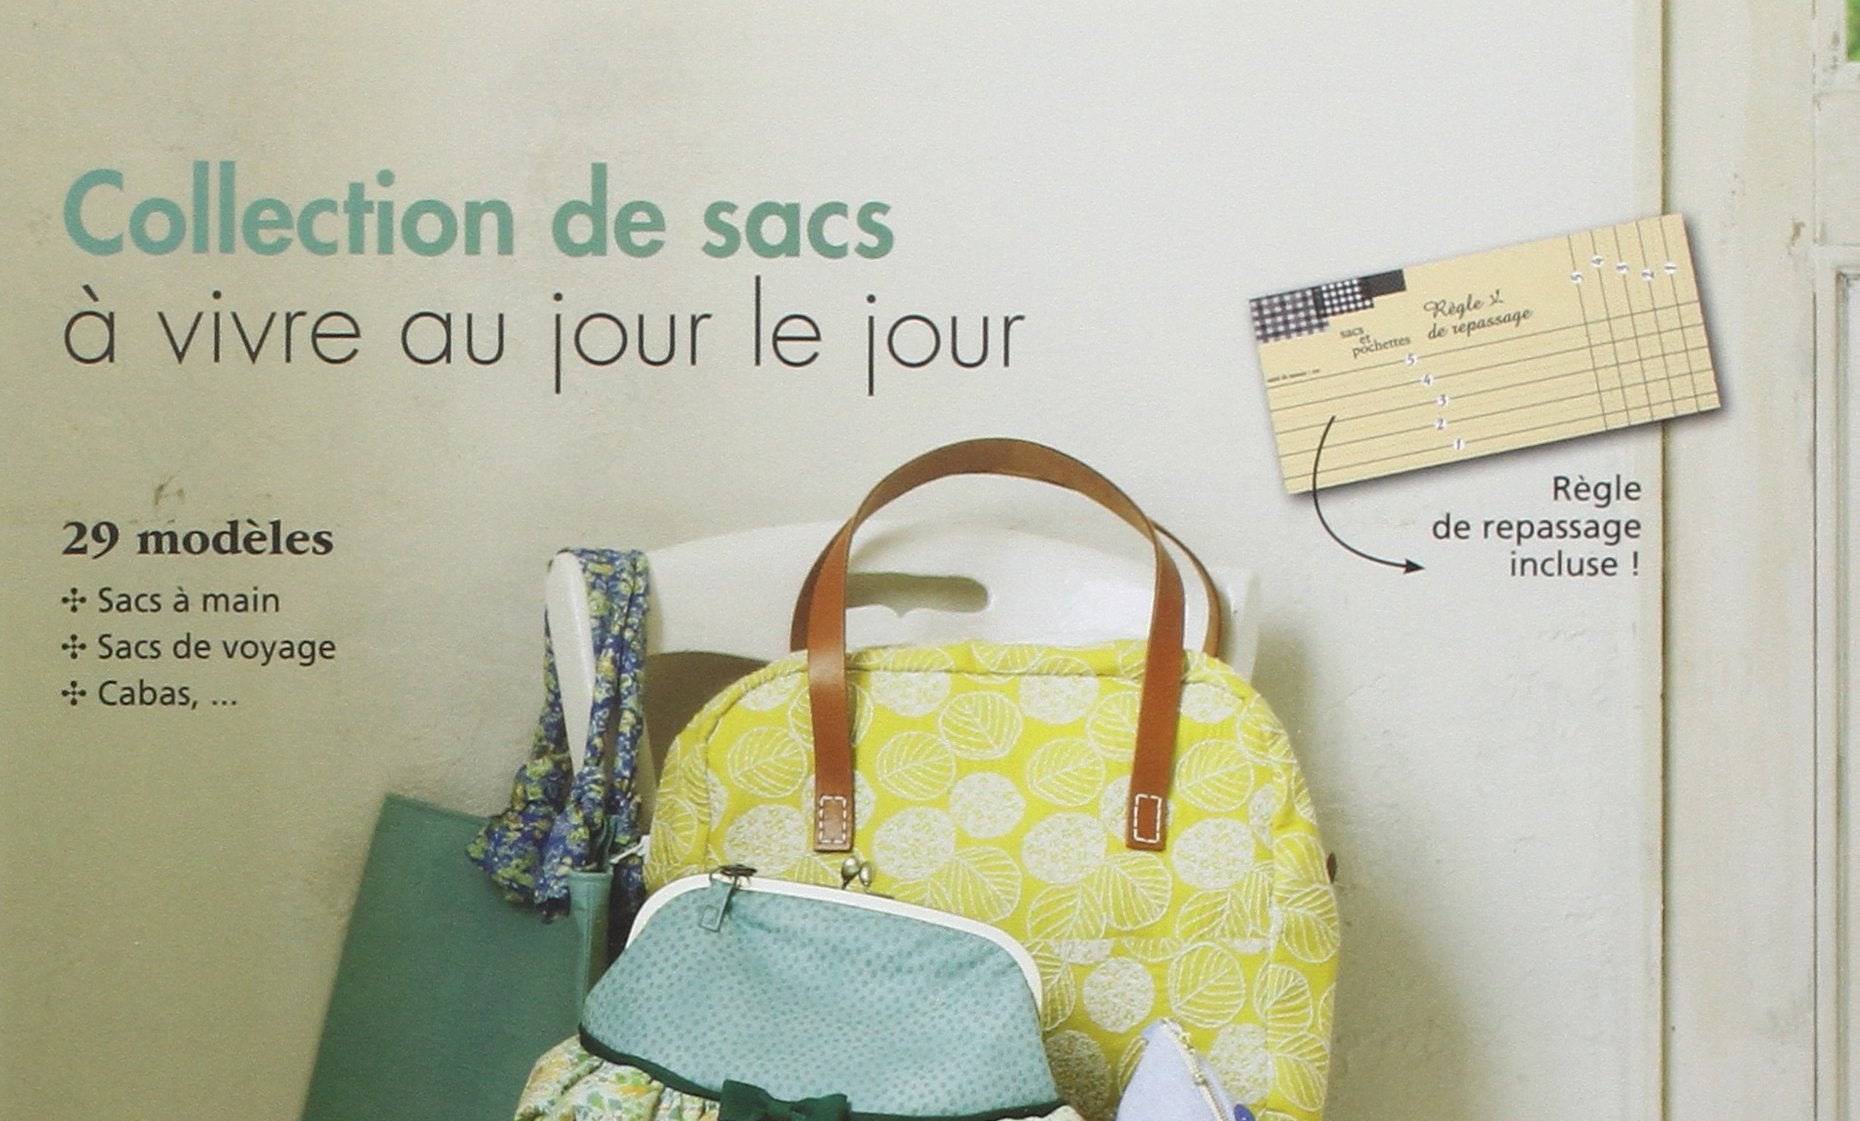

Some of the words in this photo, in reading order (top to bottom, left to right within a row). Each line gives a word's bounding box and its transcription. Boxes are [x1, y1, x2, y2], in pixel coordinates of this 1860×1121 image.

[63, 159, 513, 258] Collection
[552, 162, 665, 258] de
[703, 200, 894, 259] sacs
[1423, 293, 1485, 320] Règle
[64, 284, 115, 365] à
[157, 290, 361, 365] vivre
[400, 311, 504, 366] au
[552, 292, 712, 395] jour
[754, 275, 822, 368] le
[866, 294, 1025, 396] jour
[1340, 326, 1365, 339] sacs
[1427, 322, 1448, 340] de
[1452, 307, 1533, 336] repassage
[1352, 335, 1411, 358] pochettes
[1359, 332, 1371, 345] et
[1405, 353, 1416, 365] 5
[1421, 374, 1432, 386] 4
[1435, 418, 1446, 430] 2
[1552, 474, 1642, 509] Règle
[62, 521, 120, 560] 29
[136, 518, 334, 556] modèles
[1432, 512, 1471, 540] de
[1483, 518, 1642, 546] repassage
[1511, 550, 1619, 577] incluse
[98, 586, 162, 614] Sacs
[172, 586, 191, 614] à
[202, 586, 281, 614] main
[98, 633, 162, 660] Sacs
[172, 632, 212, 660] de
[222, 639, 337, 667] voyage
[98, 678, 200, 710] Cabas,
